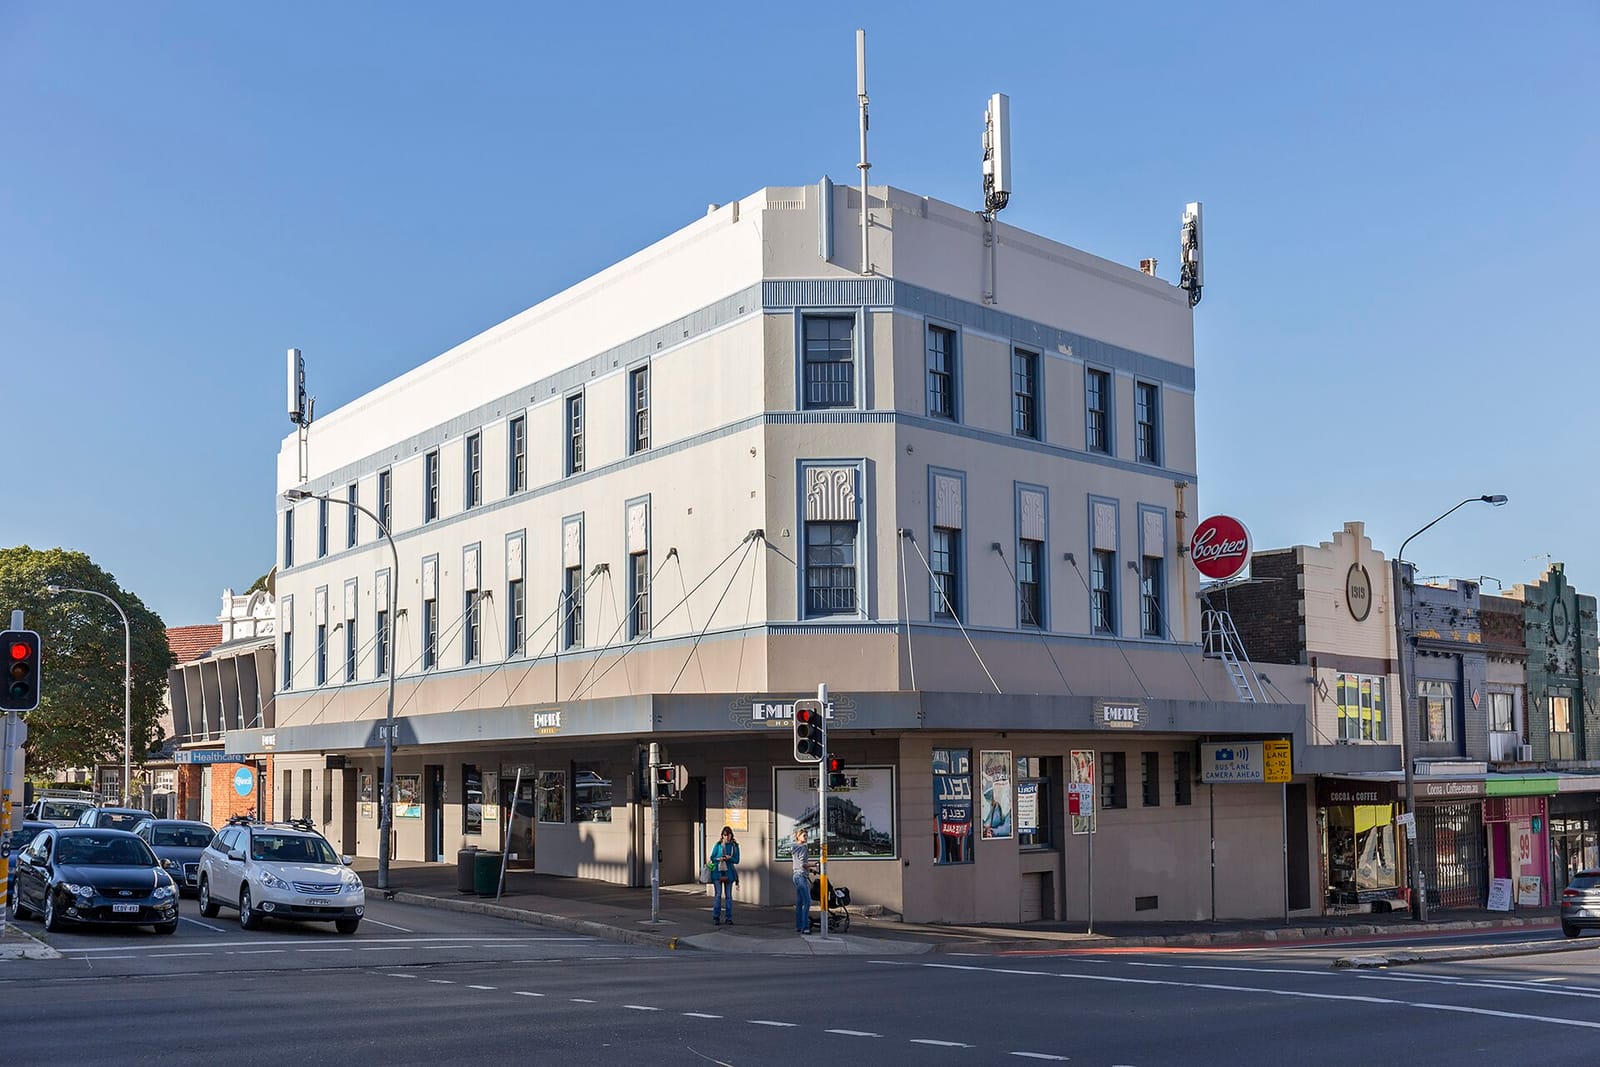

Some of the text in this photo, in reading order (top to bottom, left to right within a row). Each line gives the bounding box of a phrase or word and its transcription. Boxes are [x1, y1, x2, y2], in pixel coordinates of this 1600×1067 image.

[1193, 528, 1246, 561] Coopers
[752, 702, 834, 720] EMPE
[1103, 706, 1140, 721] EMPIRE
[533, 711, 561, 728] EMPIRE
[175, 752, 241, 762] H1 Healthcare
[1214, 763, 1250, 771] BUS LANE
[1205, 770, 1261, 779] CAMERA AHEAD
[1427, 783, 1442, 795] Cocoa
[1330, 792, 1350, 801] COCOA
[1355, 791, 1378, 801] COFFEE
